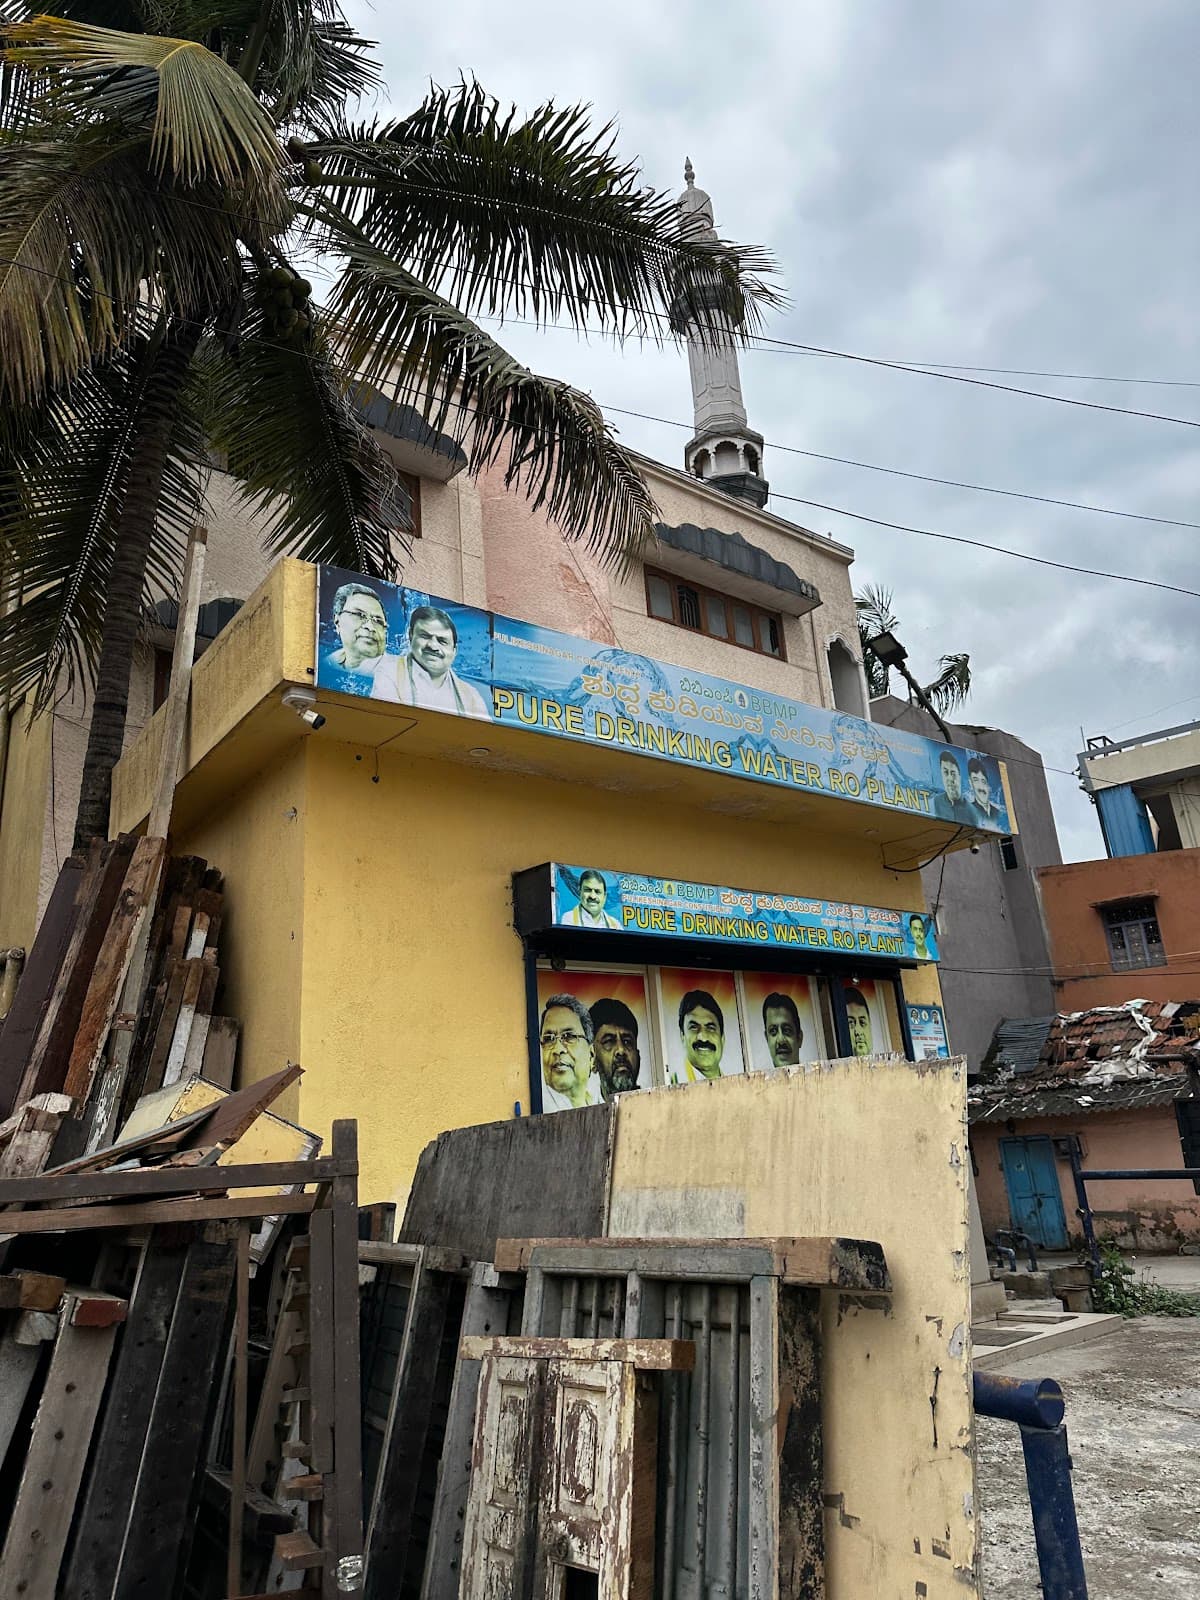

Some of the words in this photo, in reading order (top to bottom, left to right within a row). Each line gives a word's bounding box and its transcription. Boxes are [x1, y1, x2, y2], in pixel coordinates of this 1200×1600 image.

[648, 688, 763, 735] ಕುಡಿಯುವ
[770, 719, 835, 752] ನೀರಿನ
[751, 695, 798, 721] BBMP
[493, 687, 585, 736] PURE
[594, 709, 732, 769] DRINKING
[738, 745, 824, 789] WATER
[828, 766, 861, 798] RO
[866, 776, 932, 813] PLANT
[677, 884, 715, 899] BBMP
[622, 905, 677, 932] PURE
[682, 911, 769, 941] DRINKING
[773, 922, 828, 948] WATER
[832, 930, 855, 950] RO
[858, 932, 904, 954] PLANT
